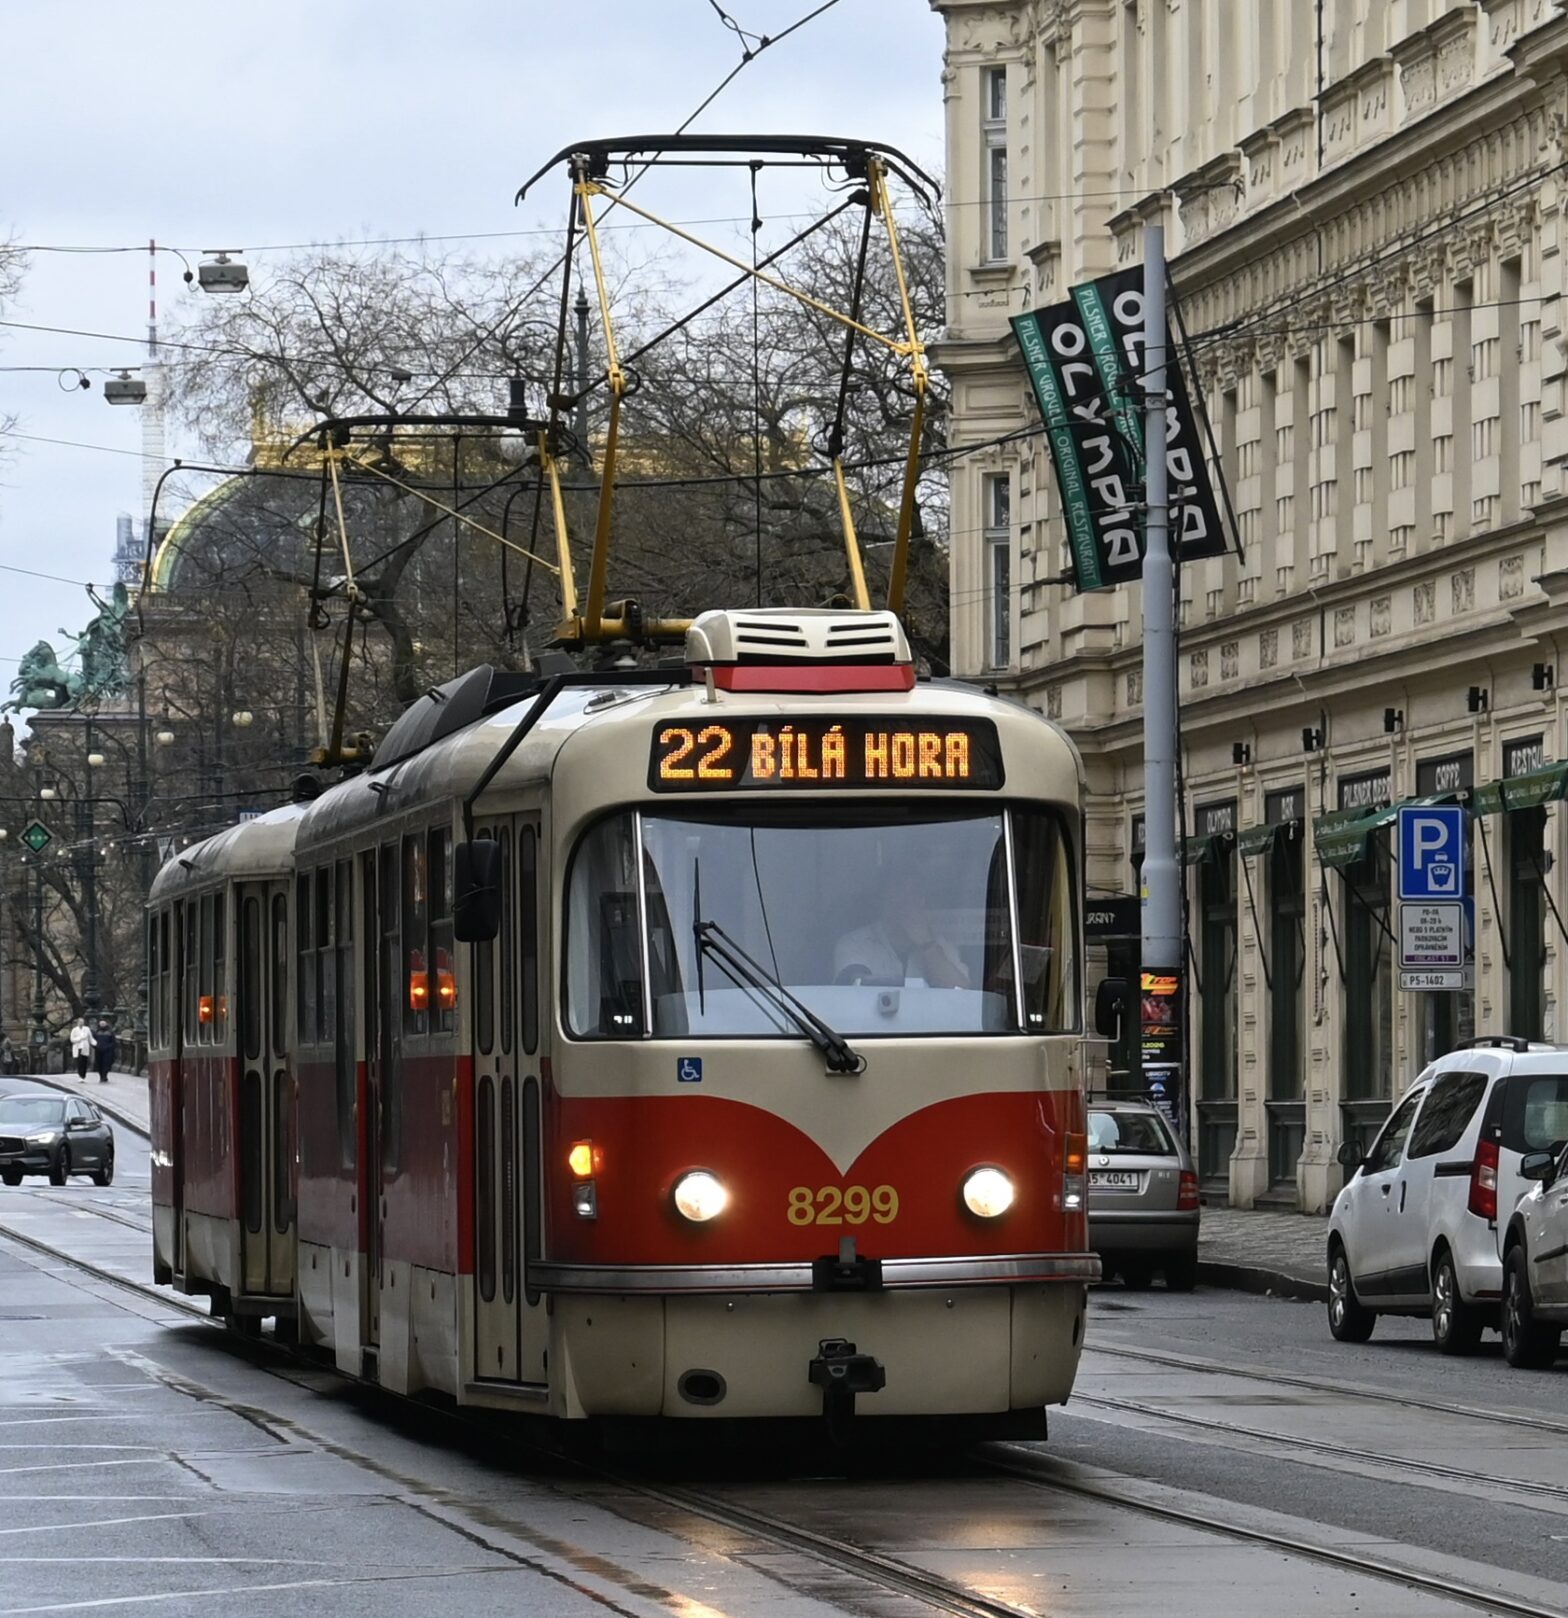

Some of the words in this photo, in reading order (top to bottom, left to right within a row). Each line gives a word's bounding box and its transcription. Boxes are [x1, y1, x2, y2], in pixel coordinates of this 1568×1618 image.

[1079, 289, 1108, 342] PILSNER
[1020, 319, 1048, 372] PILSNER
[1057, 436, 1081, 497] ORIGINAL
[1071, 501, 1097, 581] RESTAURANT
[1051, 322, 1140, 566] OLYMPIA
[660, 725, 732, 779] 22
[751, 725, 846, 779] BÍLÁ
[865, 732, 969, 778] HORA
[1343, 781, 1372, 808] PILSNER
[1413, 818, 1449, 870] P
[1409, 975, 1445, 986] P5-1402
[1106, 1173, 1133, 1185] 4041
[787, 1185, 900, 1226] 8299
